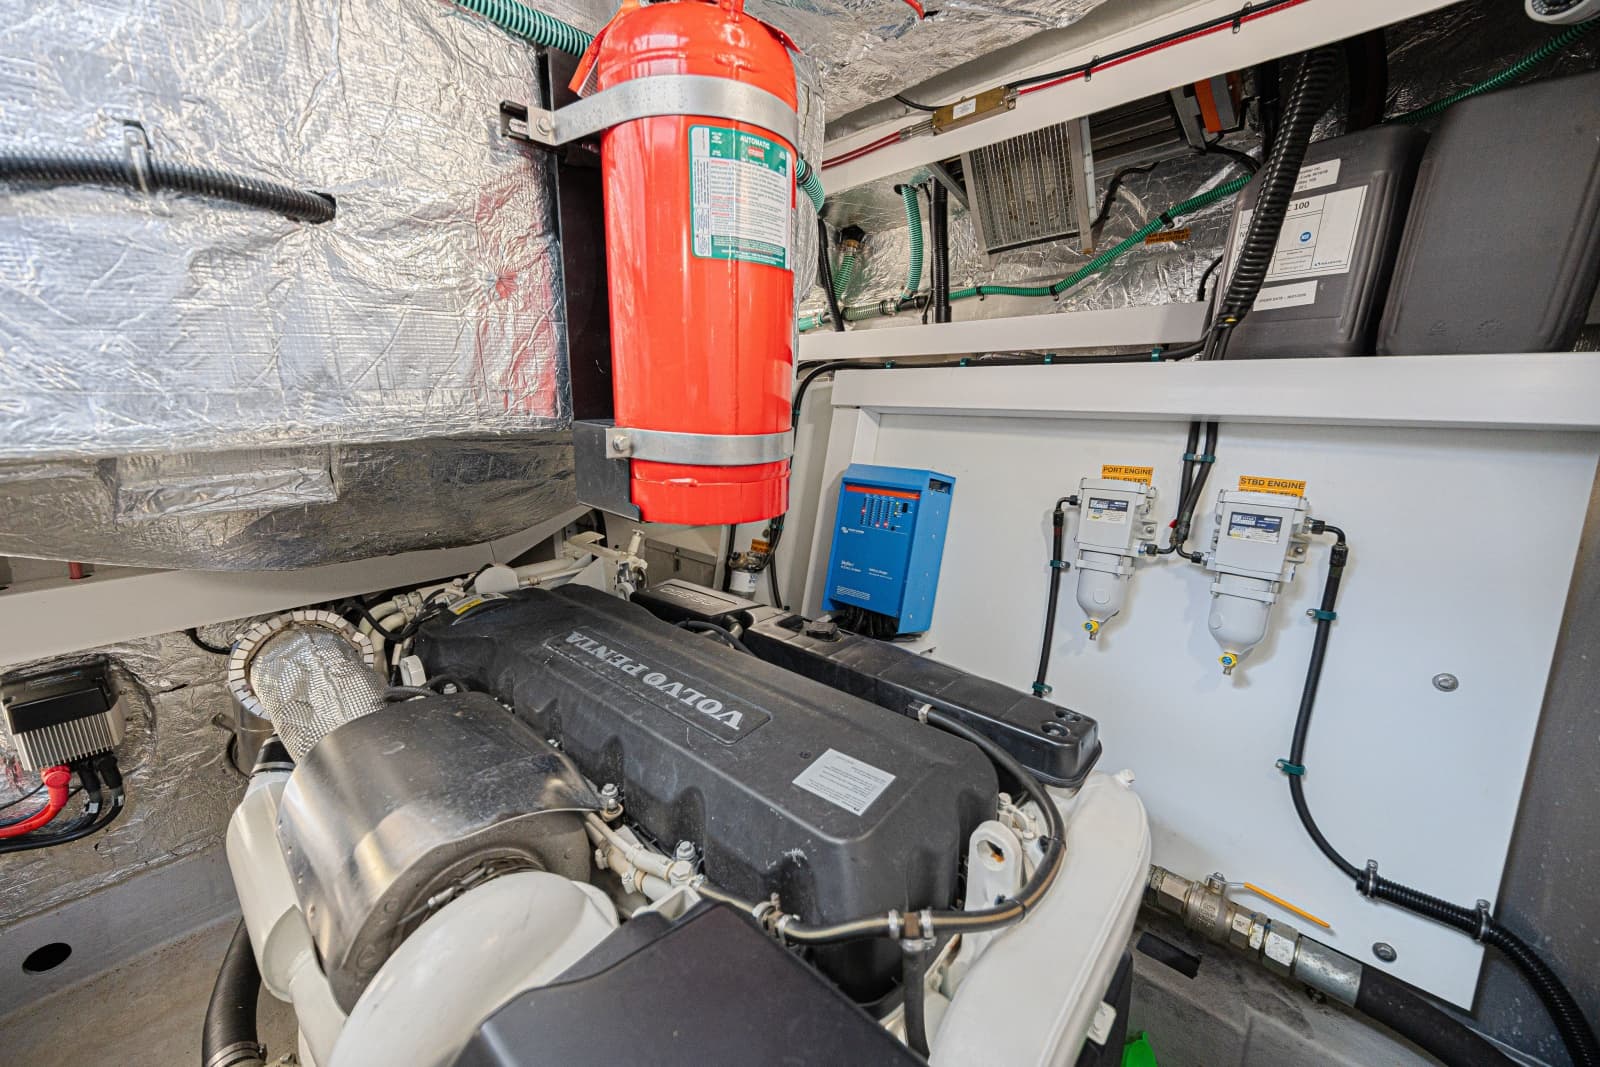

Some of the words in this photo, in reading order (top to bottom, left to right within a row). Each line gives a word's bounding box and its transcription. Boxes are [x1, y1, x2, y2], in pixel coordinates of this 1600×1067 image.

[740, 135, 770, 150] AUTOMATIC
[1294, 201, 1310, 211] 100
[1103, 466, 1122, 474] PORT
[1124, 467, 1153, 475] ENGINE
[1240, 477, 1265, 486] STBD
[1267, 480, 1305, 490] ENGINE
[564, 631, 649, 677] PENTA
[642, 672, 744, 730] VOLVO
